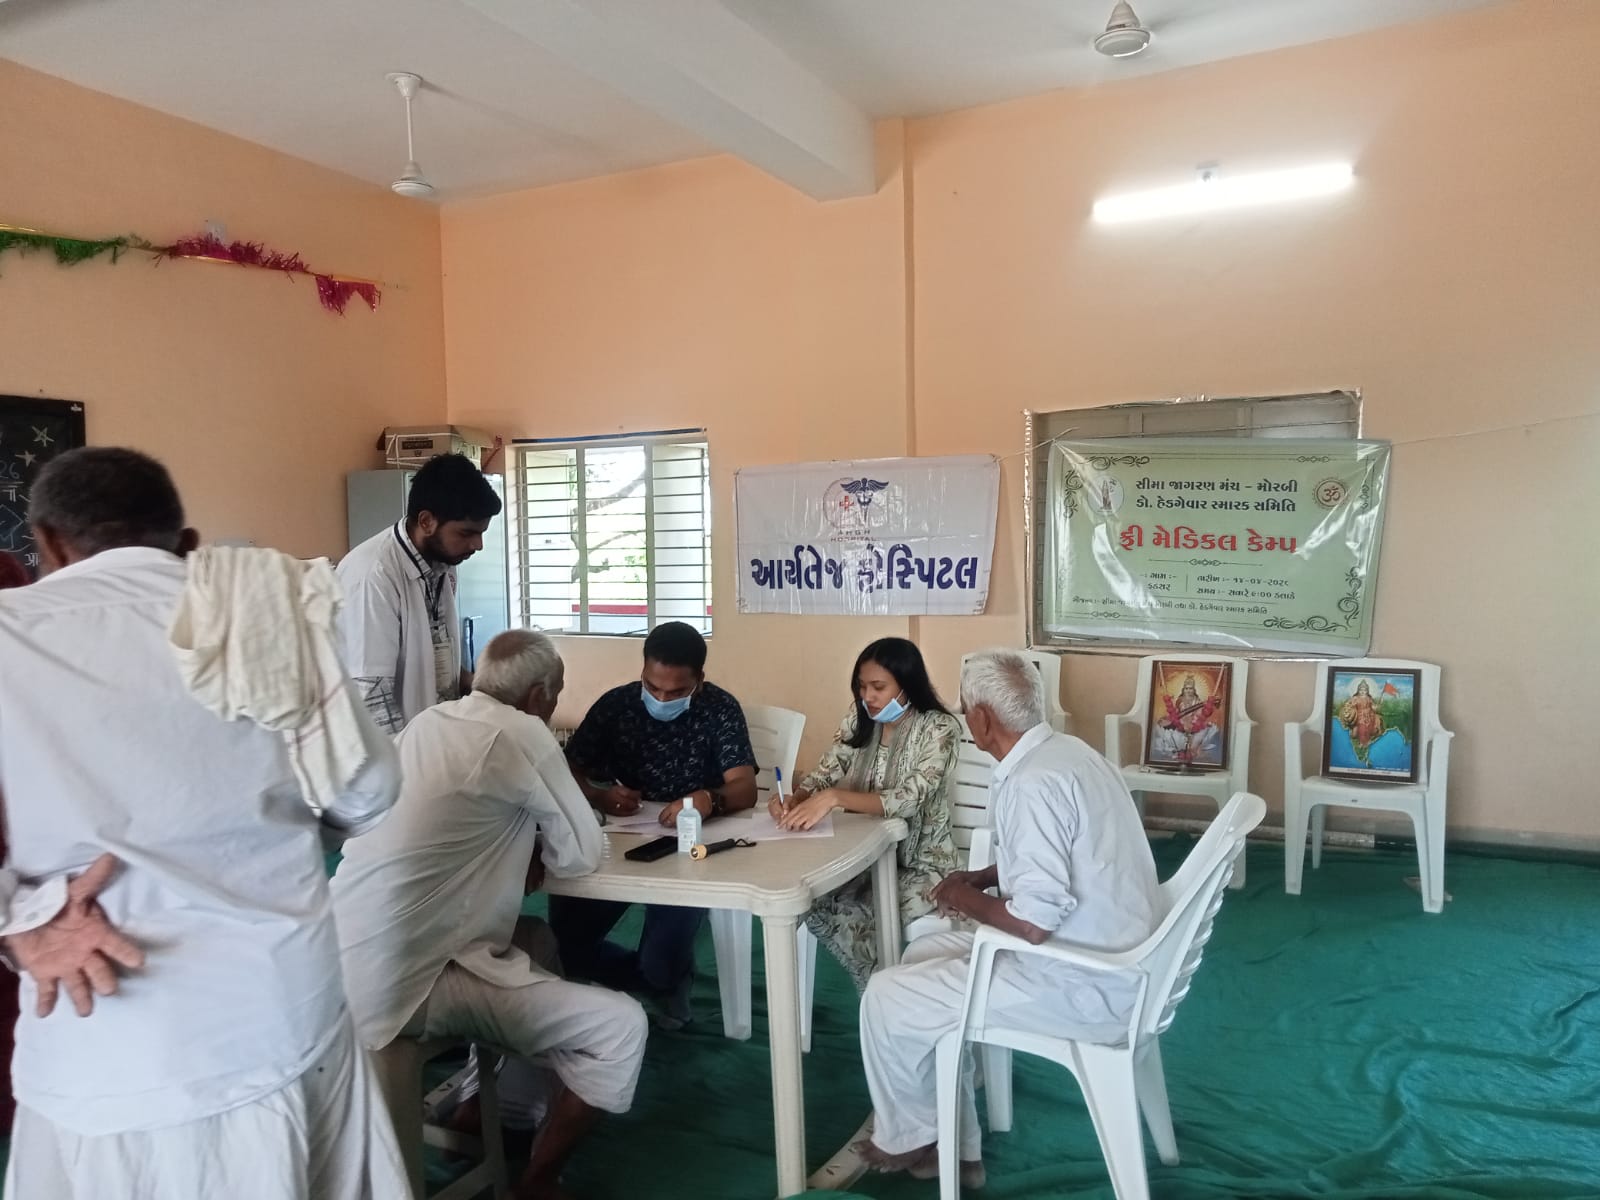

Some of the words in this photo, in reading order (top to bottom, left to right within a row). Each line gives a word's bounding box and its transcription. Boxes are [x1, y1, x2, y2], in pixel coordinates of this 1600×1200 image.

[1136, 477, 1164, 490] સીમા
[1168, 480, 1215, 491] જાગરણ
[1219, 478, 1240, 491] મંચ
[1257, 478, 1298, 492] મોરબી
[1136, 495, 1153, 508] ડો.
[1157, 495, 1207, 510] હેડગેવાર
[1211, 499, 1250, 511] સ્મારક
[1253, 498, 1297, 512] સમિતિ
[1120, 524, 1144, 551] ફ્રી
[1152, 524, 1237, 551] મેડિકલ
[1246, 527, 1297, 554] કેમ્પ
[750, 544, 844, 590] આર્યતેજ
[857, 543, 979, 594] હોસ્પિટલ
